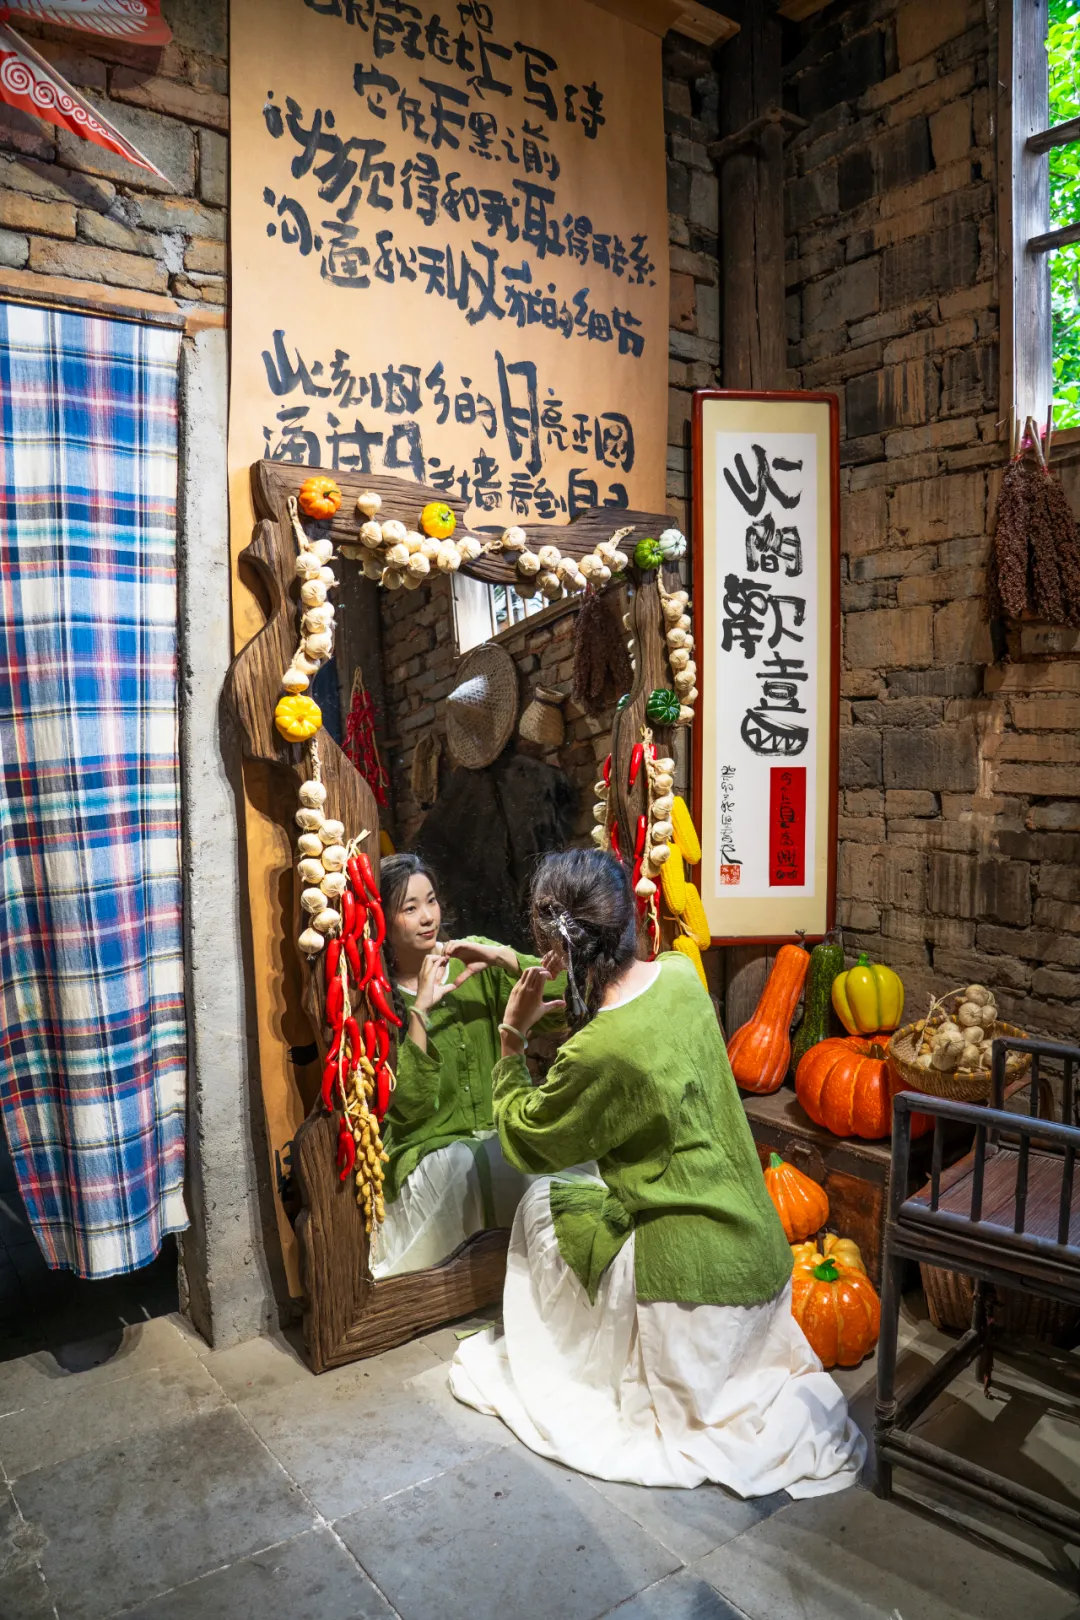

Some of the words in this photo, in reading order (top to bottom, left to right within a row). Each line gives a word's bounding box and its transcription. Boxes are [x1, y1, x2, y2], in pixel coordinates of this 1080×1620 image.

[261, 329, 635, 477] 此刻故乡的月亮正圆
